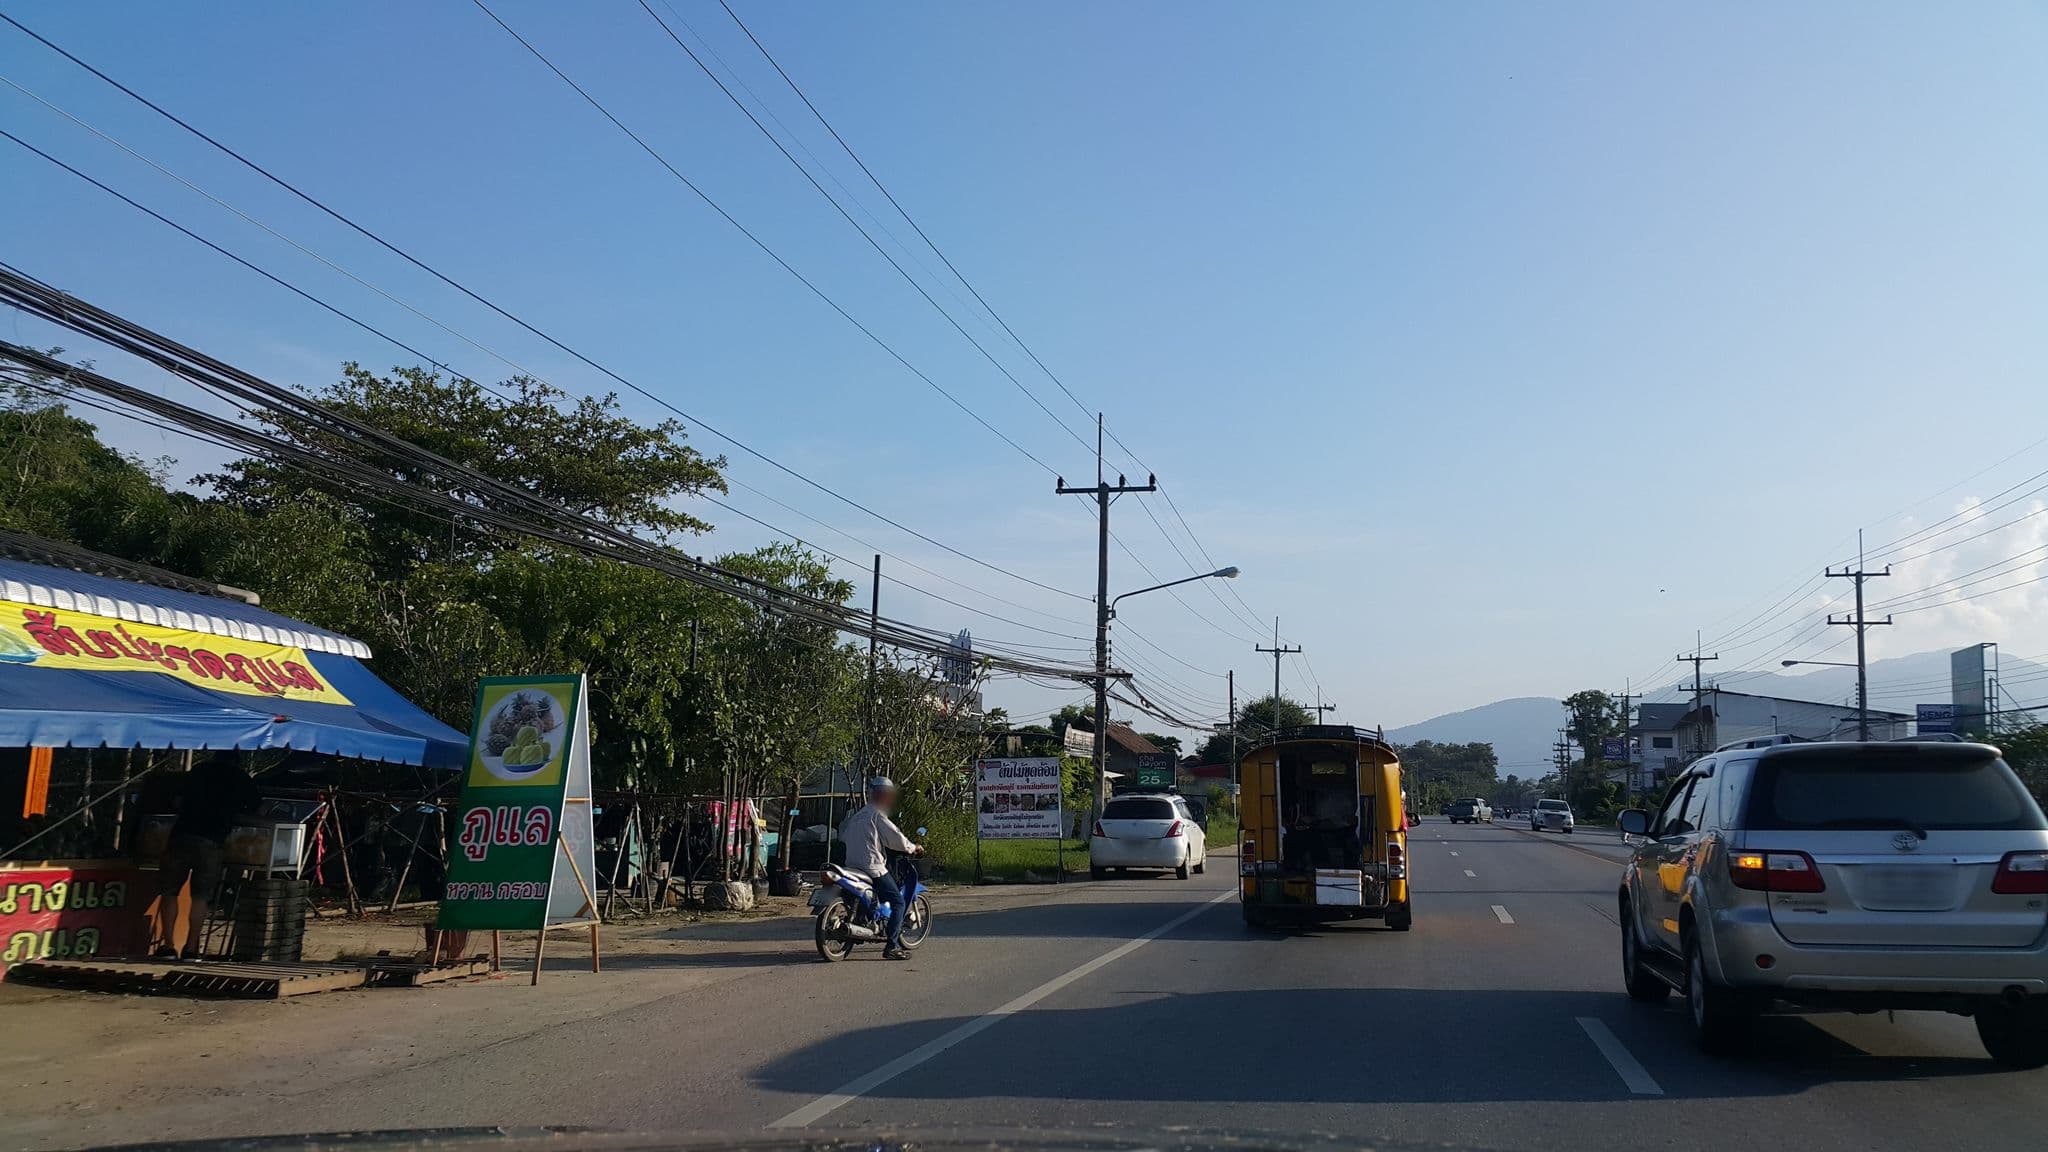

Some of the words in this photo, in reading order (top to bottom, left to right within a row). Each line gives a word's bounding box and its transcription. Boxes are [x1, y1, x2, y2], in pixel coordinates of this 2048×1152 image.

[22, 608, 325, 696] สับปะรดภูแล
[1140, 776, 1160, 784] 25
[459, 805, 552, 861] ภูแล
[446, 881, 493, 900] หวาน
[497, 881, 547, 900] กรอบ
